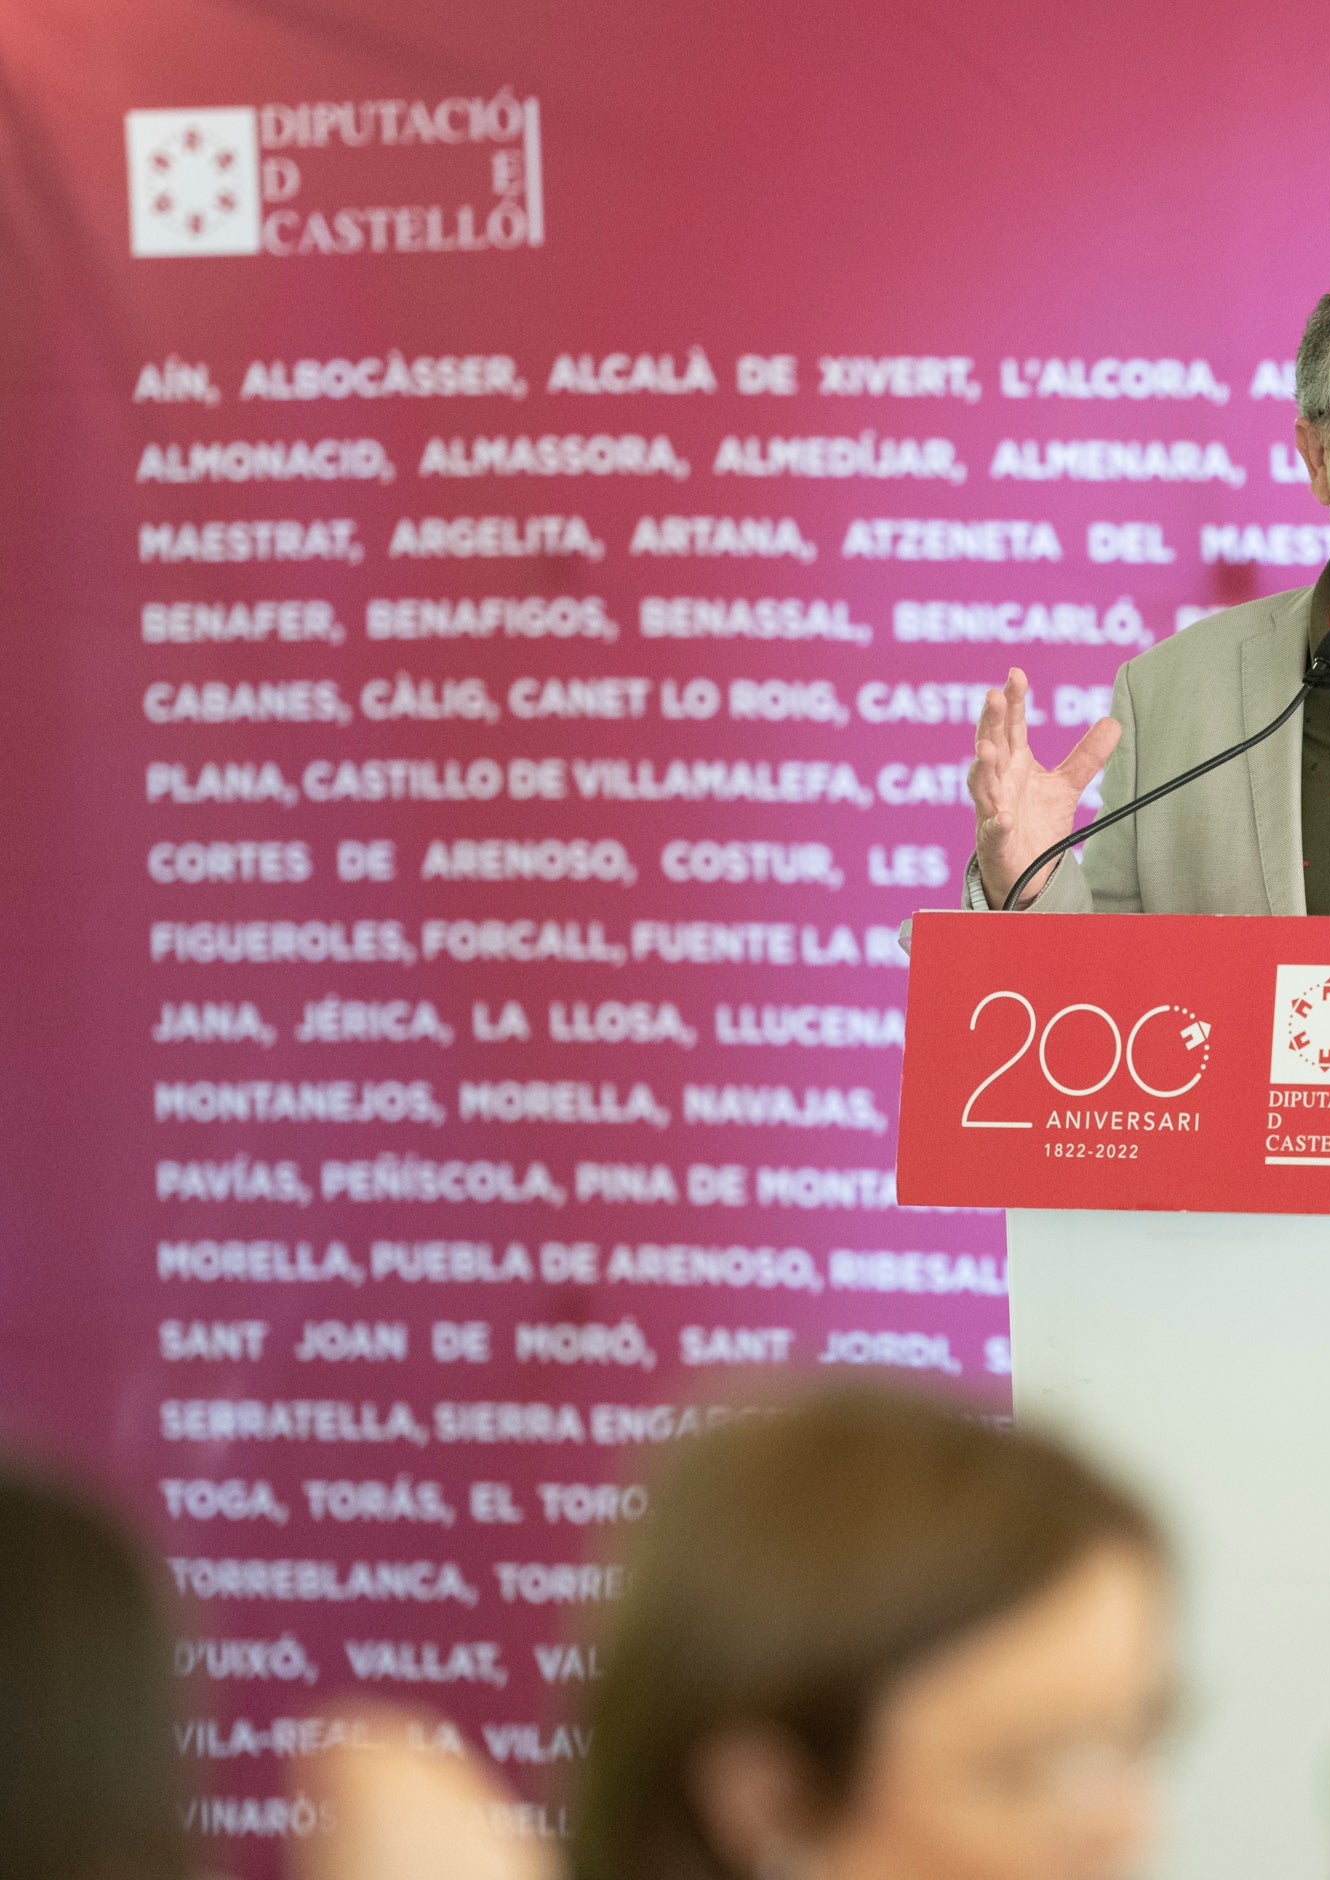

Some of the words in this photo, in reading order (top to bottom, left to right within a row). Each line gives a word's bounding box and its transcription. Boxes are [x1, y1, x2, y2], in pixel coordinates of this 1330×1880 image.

[262, 89, 524, 146] DIPUTACIÓ
[262, 159, 301, 201] D
[492, 150, 524, 197] E
[262, 197, 525, 255] CASTELLÓ
[134, 354, 220, 405] AÍN,
[241, 349, 528, 401] ALBOCÀSSER,
[548, 344, 717, 394] ALCALÀ
[737, 353, 797, 395] DE
[818, 355, 981, 403] XIVERT,
[1001, 357, 1230, 404] L'ALCORA,
[137, 439, 395, 485] ALMONACID,
[419, 435, 690, 480] ALMASSORA,
[713, 430, 967, 485] ALMEDÍJAR,
[990, 440, 1246, 489] ALMENARA,
[139, 519, 364, 565] MAESTRAT,
[389, 515, 605, 562] ARGELITA,
[630, 517, 817, 562] ARTANA,
[842, 517, 1061, 562] ATZENETA
[1087, 520, 1175, 563] DEL
[142, 601, 345, 645] BENAFER,
[367, 597, 619, 645] BENAFIGOS,
[640, 597, 873, 646] BENASSAL,
[892, 596, 1154, 648] BENICARLÓ,
[143, 680, 352, 727] CABANES,
[360, 672, 500, 724] CÀLIG,
[508, 677, 652, 722] CANET
[661, 678, 721, 720] LO
[729, 678, 850, 728] ROIG,
[145, 761, 299, 807] PLANA,
[302, 759, 503, 801] CASTILLO
[507, 758, 567, 800] DE
[571, 758, 874, 808] VILLAMALEFA,
[148, 841, 312, 883] CORTES
[336, 840, 396, 882] DE
[421, 838, 637, 887] ARENOSO,
[661, 838, 845, 892] COSTUR,
[867, 845, 949, 887] LES
[149, 920, 417, 968] FIGUEROLES,
[421, 918, 628, 968] FORCALL,
[631, 920, 795, 964] FUENTE
[801, 923, 860, 966] LA
[152, 1001, 277, 1049] JANA,
[296, 990, 455, 1049] JÉRICA,
[472, 1000, 530, 1043] LA
[549, 1000, 697, 1051] LLOSA,
[153, 1081, 447, 1129] MONTANEJOS,
[459, 1080, 672, 1130] MORELLA,
[683, 1083, 888, 1136] NAVAJAS,
[1046, 1109, 1201, 1132] ANIVERSARI
[1267, 1113, 1283, 1130] D
[1043, 1143, 1139, 1160] 1822-2022
[156, 1150, 314, 1208] PAVÍAS,
[321, 1150, 567, 1208] PEÑÍSCOLA,
[575, 1161, 678, 1204] PINA
[687, 1163, 748, 1206] DE
[157, 1241, 366, 1288] MORELLA,
[370, 1240, 533, 1284] PUEBLA
[539, 1241, 598, 1284] DE
[606, 1243, 825, 1294] ARENOSO,
[159, 1320, 270, 1361] SANT
[294, 1320, 410, 1362] JOAN
[431, 1320, 491, 1363] DE
[515, 1316, 657, 1371] MORÓ,
[678, 1325, 795, 1366] SANT
[819, 1330, 963, 1375] JORDI,
[159, 1400, 429, 1448] SERRATELLA,
[434, 1402, 585, 1444] SIERRA
[159, 1478, 290, 1527] TOGA,
[303, 1473, 456, 1528] TORÁS,
[469, 1482, 524, 1524] EL
[168, 1557, 479, 1607] TORREBLANCA,
[344, 1639, 509, 1690] VALLAT,
